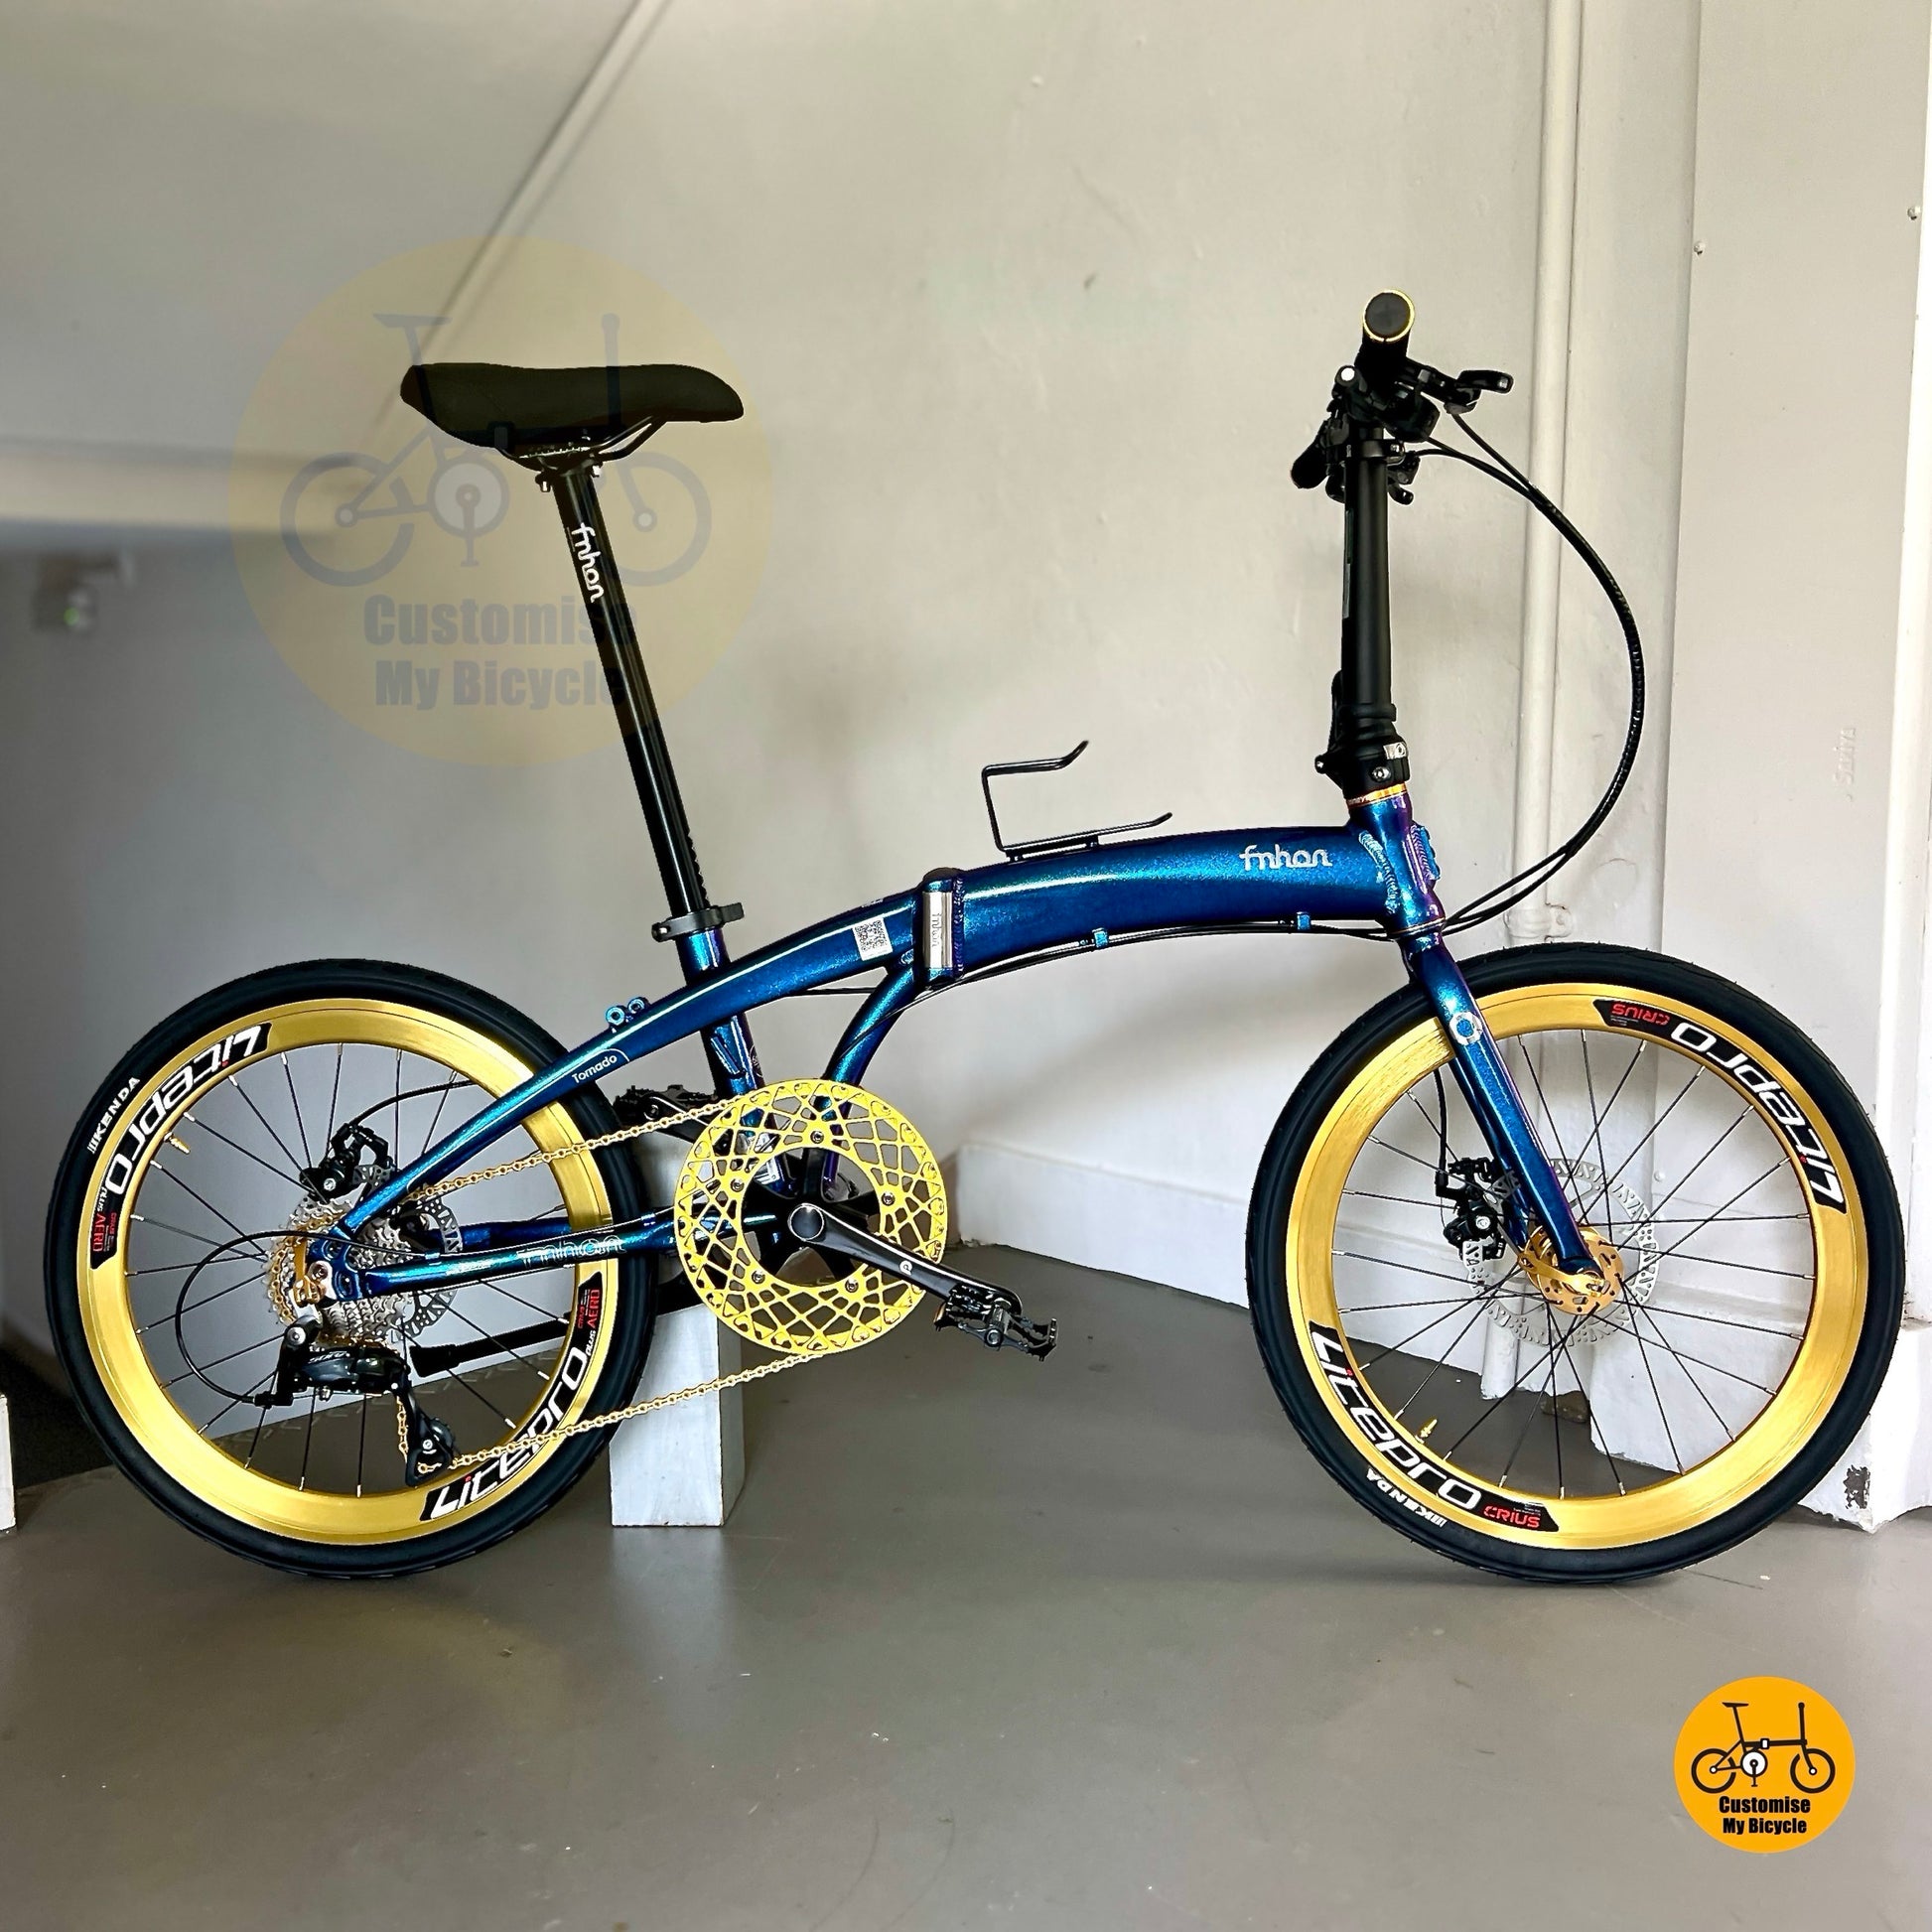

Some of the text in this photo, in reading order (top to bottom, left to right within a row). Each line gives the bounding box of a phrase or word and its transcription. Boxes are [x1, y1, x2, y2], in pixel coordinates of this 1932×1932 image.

[1611, 1003, 1670, 1026] CRIUS
[572, 1054, 618, 1083] Tornado
[93, 1077, 141, 1142] KENDA
[1366, 1465, 1439, 1523] KENDA
[1483, 1505, 1541, 1528] CRIUS
